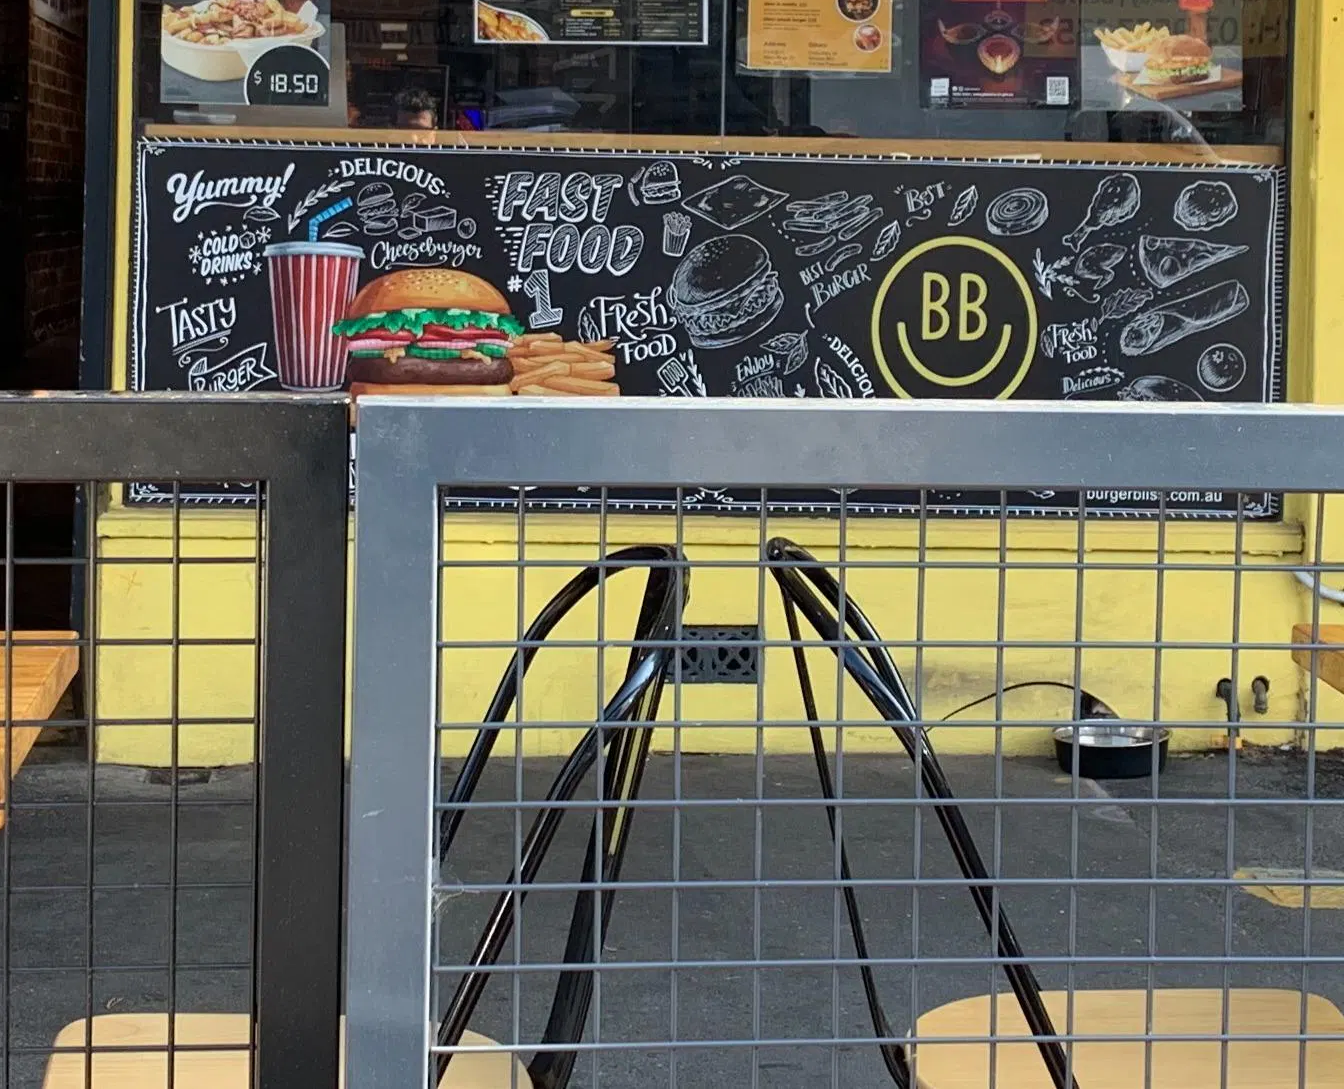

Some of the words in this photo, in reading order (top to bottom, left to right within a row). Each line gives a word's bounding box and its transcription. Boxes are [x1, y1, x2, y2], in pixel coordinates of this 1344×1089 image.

[254, 70, 262, 86] $
[270, 74, 319, 94] 18.50
[340, 158, 445, 195] DELICIOUS
[167, 162, 296, 223] Yummy!
[497, 172, 623, 221] FAST
[202, 236, 239, 256] COLD
[371, 240, 483, 269] Cheeseburger
[518, 223, 644, 276] FOOD
[201, 251, 253, 277] DRINKS
[799, 262, 824, 286] BEST
[922, 271, 988, 342] BB
[156, 297, 237, 347] TASTY
[617, 333, 677, 366] FOOD
[1061, 344, 1098, 365] FOOD
[735, 353, 775, 383] ENJOY
[1062, 371, 1112, 395] Delicious
[1086, 490, 1223, 504] burgerblis.com.au
